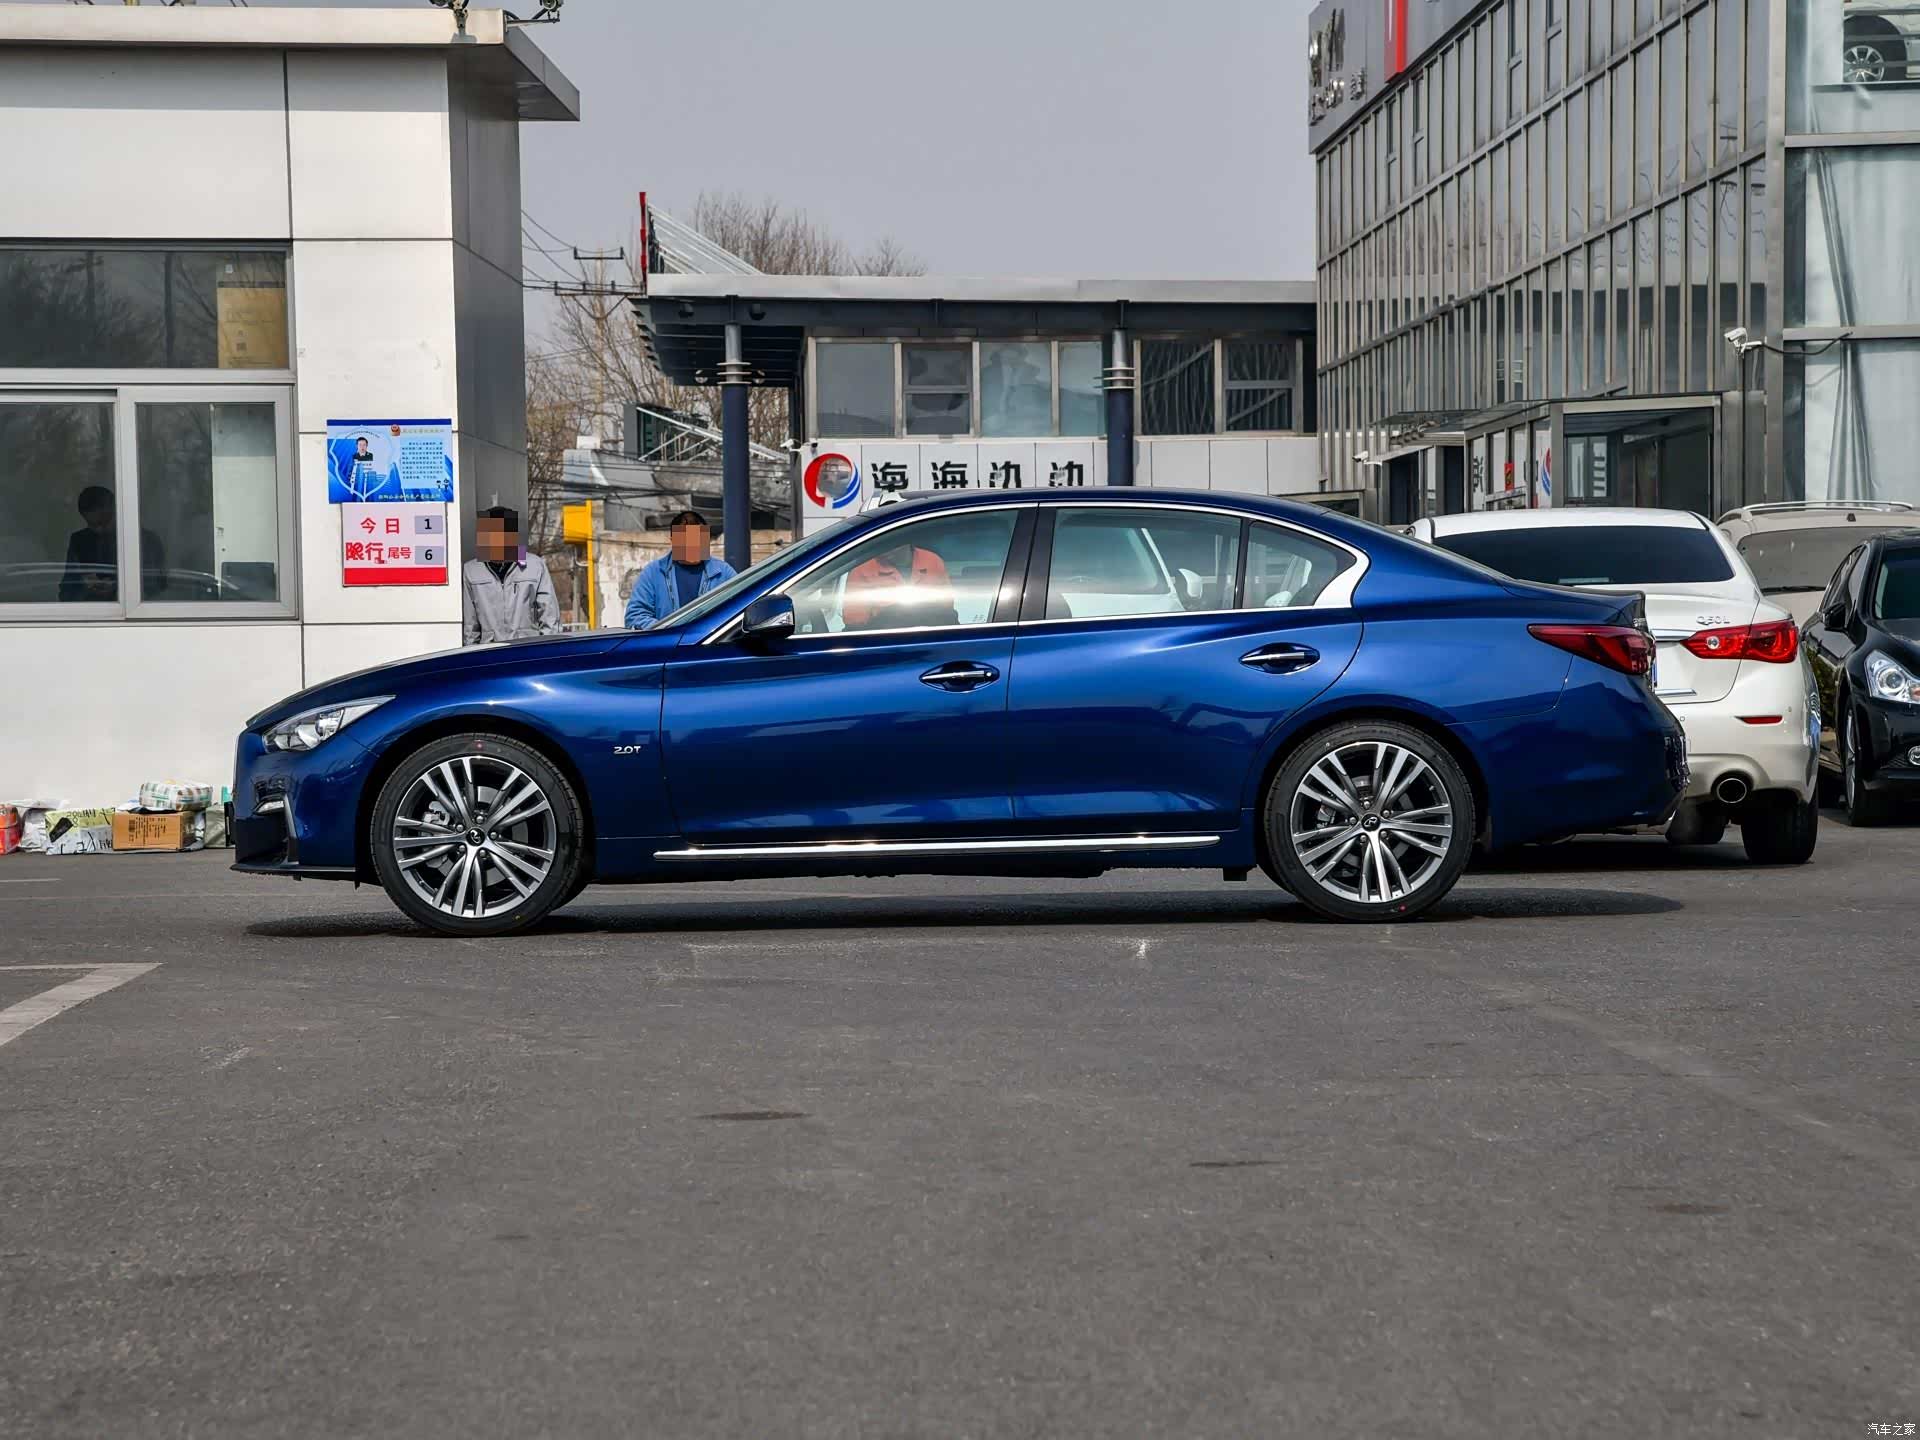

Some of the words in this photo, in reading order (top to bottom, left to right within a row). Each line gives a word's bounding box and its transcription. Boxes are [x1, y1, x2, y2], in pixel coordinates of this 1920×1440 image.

[361, 518, 400, 534] 今日
[424, 518, 432, 530] 1
[387, 547, 411, 559] 尾号
[424, 549, 433, 561] 6
